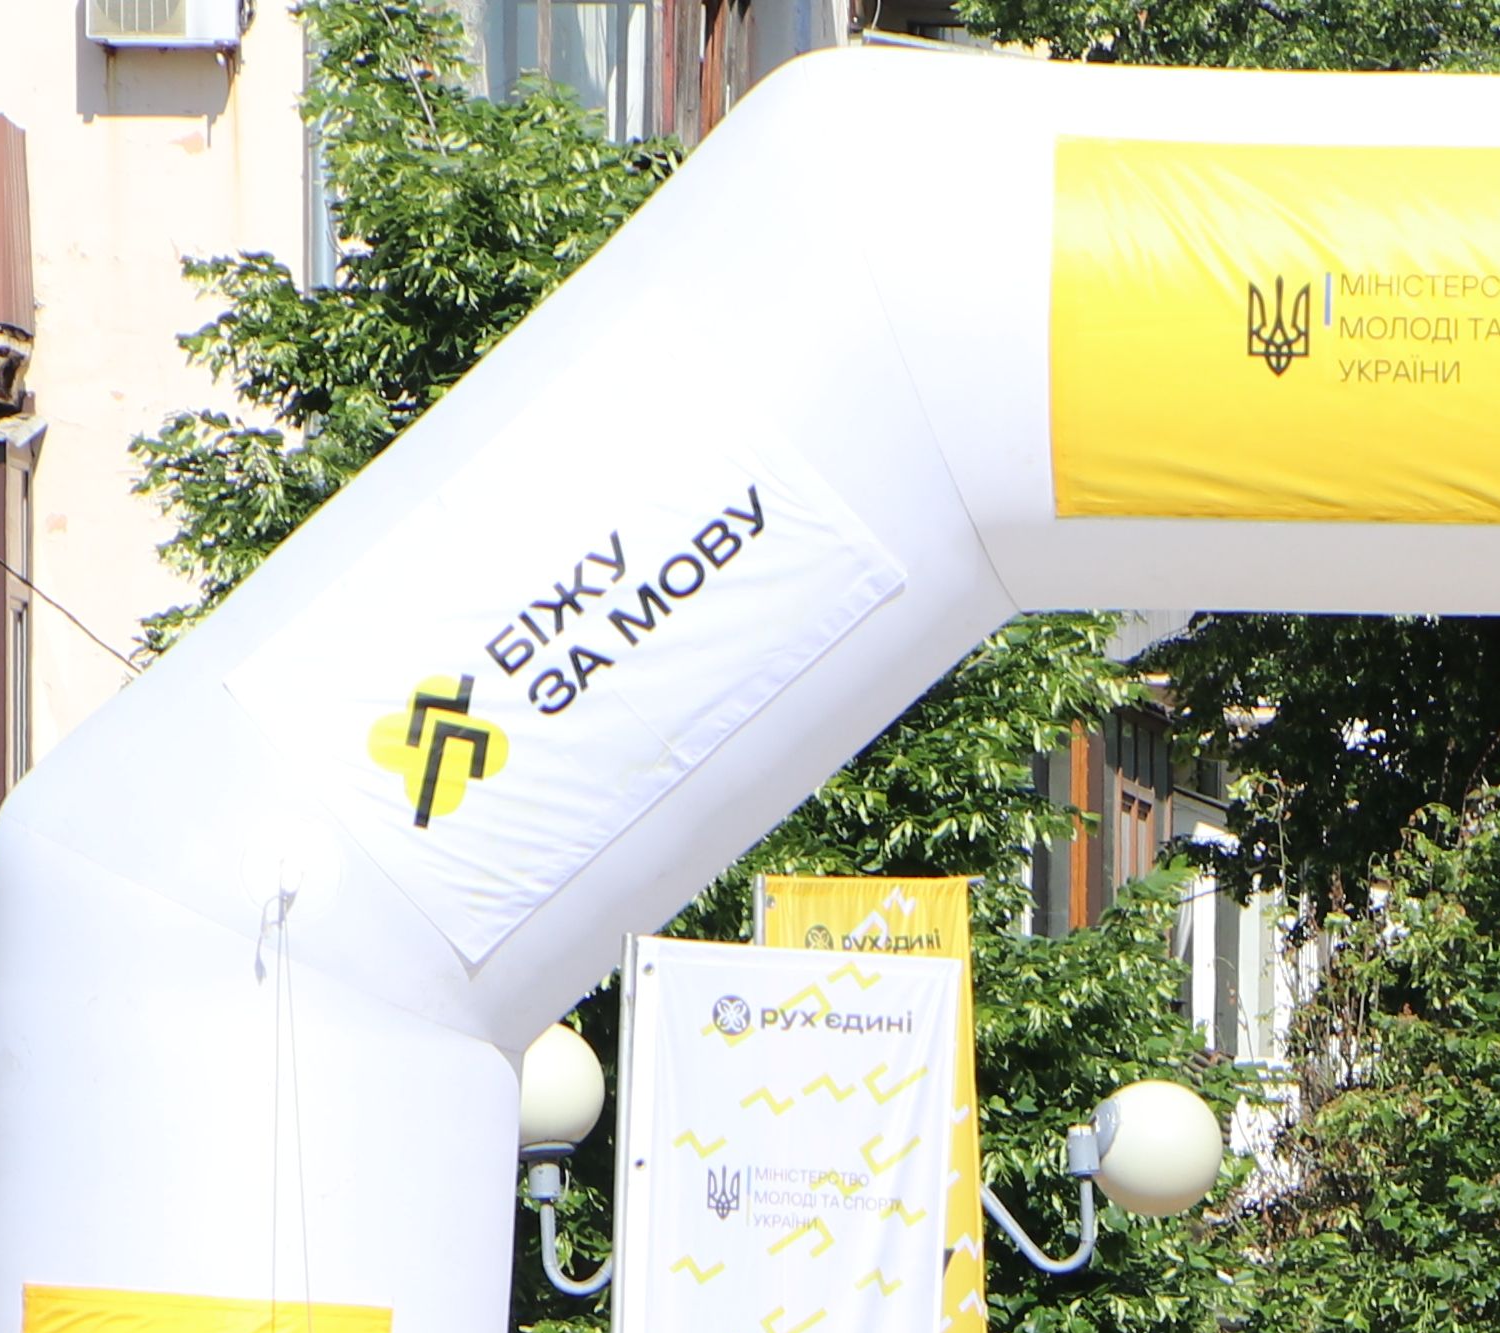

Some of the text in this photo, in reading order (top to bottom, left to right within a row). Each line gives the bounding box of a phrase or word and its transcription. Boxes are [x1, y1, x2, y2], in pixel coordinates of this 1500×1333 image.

[1339, 316, 1460, 343] МОЛОДІ
[1339, 354, 1461, 384] УКРАЇНИ
[485, 529, 627, 675] БІЖУ
[528, 484, 766, 716] ЗА МОВУ
[760, 1007, 912, 1034] рух єдині
[754, 1166, 870, 1187] МІНІСТЕРСТВО
[753, 1190, 817, 1209] МОЛОДІ
[820, 1193, 840, 1209] ТА
